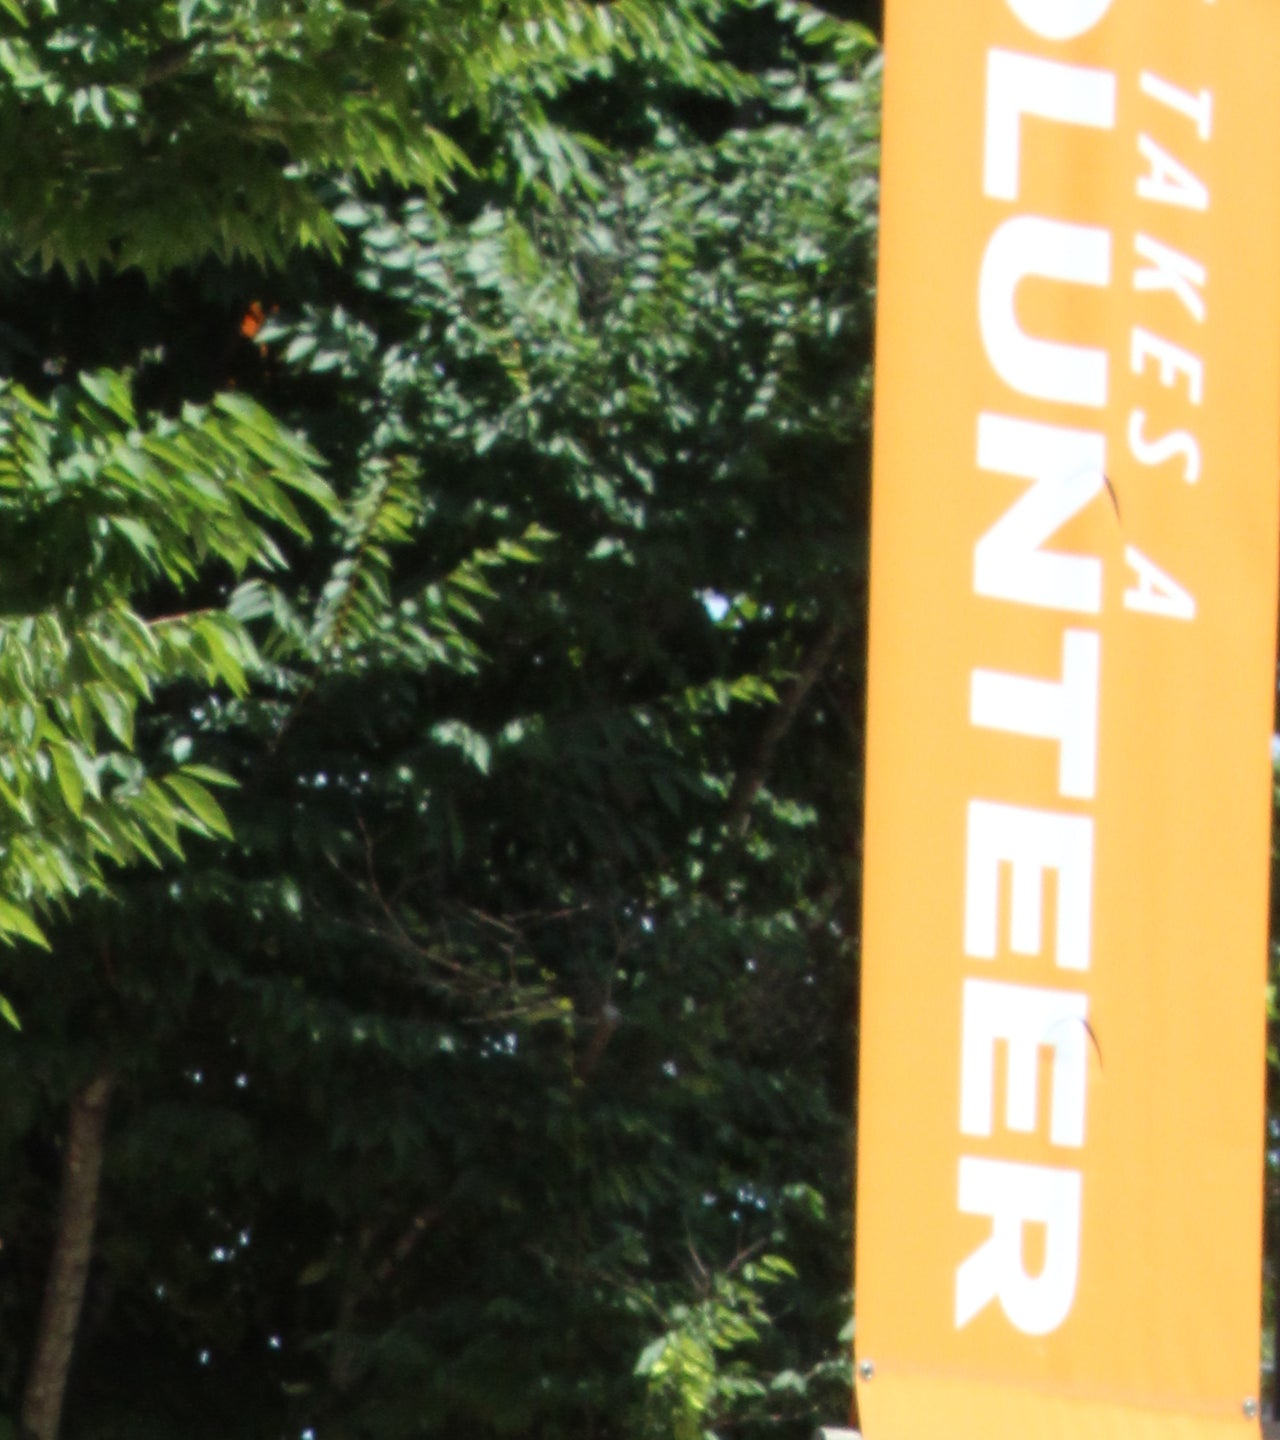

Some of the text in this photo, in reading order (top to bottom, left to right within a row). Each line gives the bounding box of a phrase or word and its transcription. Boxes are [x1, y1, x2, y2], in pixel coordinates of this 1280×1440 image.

[953, 0, 1117, 1337] LUNTEER
[1122, 70, 1213, 622] TAKES A
